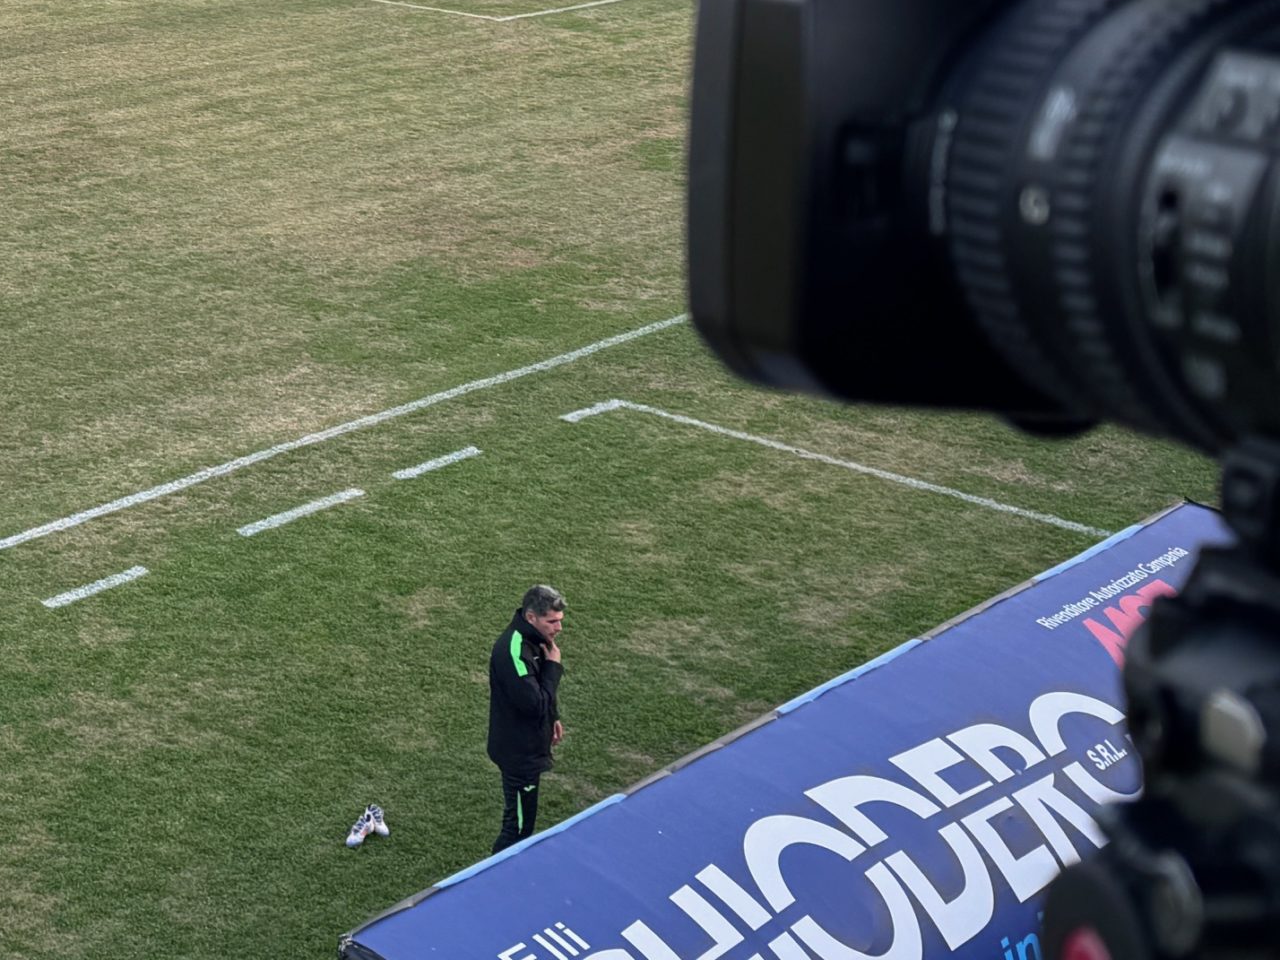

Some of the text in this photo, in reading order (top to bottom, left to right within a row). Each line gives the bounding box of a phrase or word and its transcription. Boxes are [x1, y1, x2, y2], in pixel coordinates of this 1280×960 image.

[1035, 547, 1189, 630] Rivenditore Autorizzato Campania
[1086, 739, 1128, 770] S.R.L.
